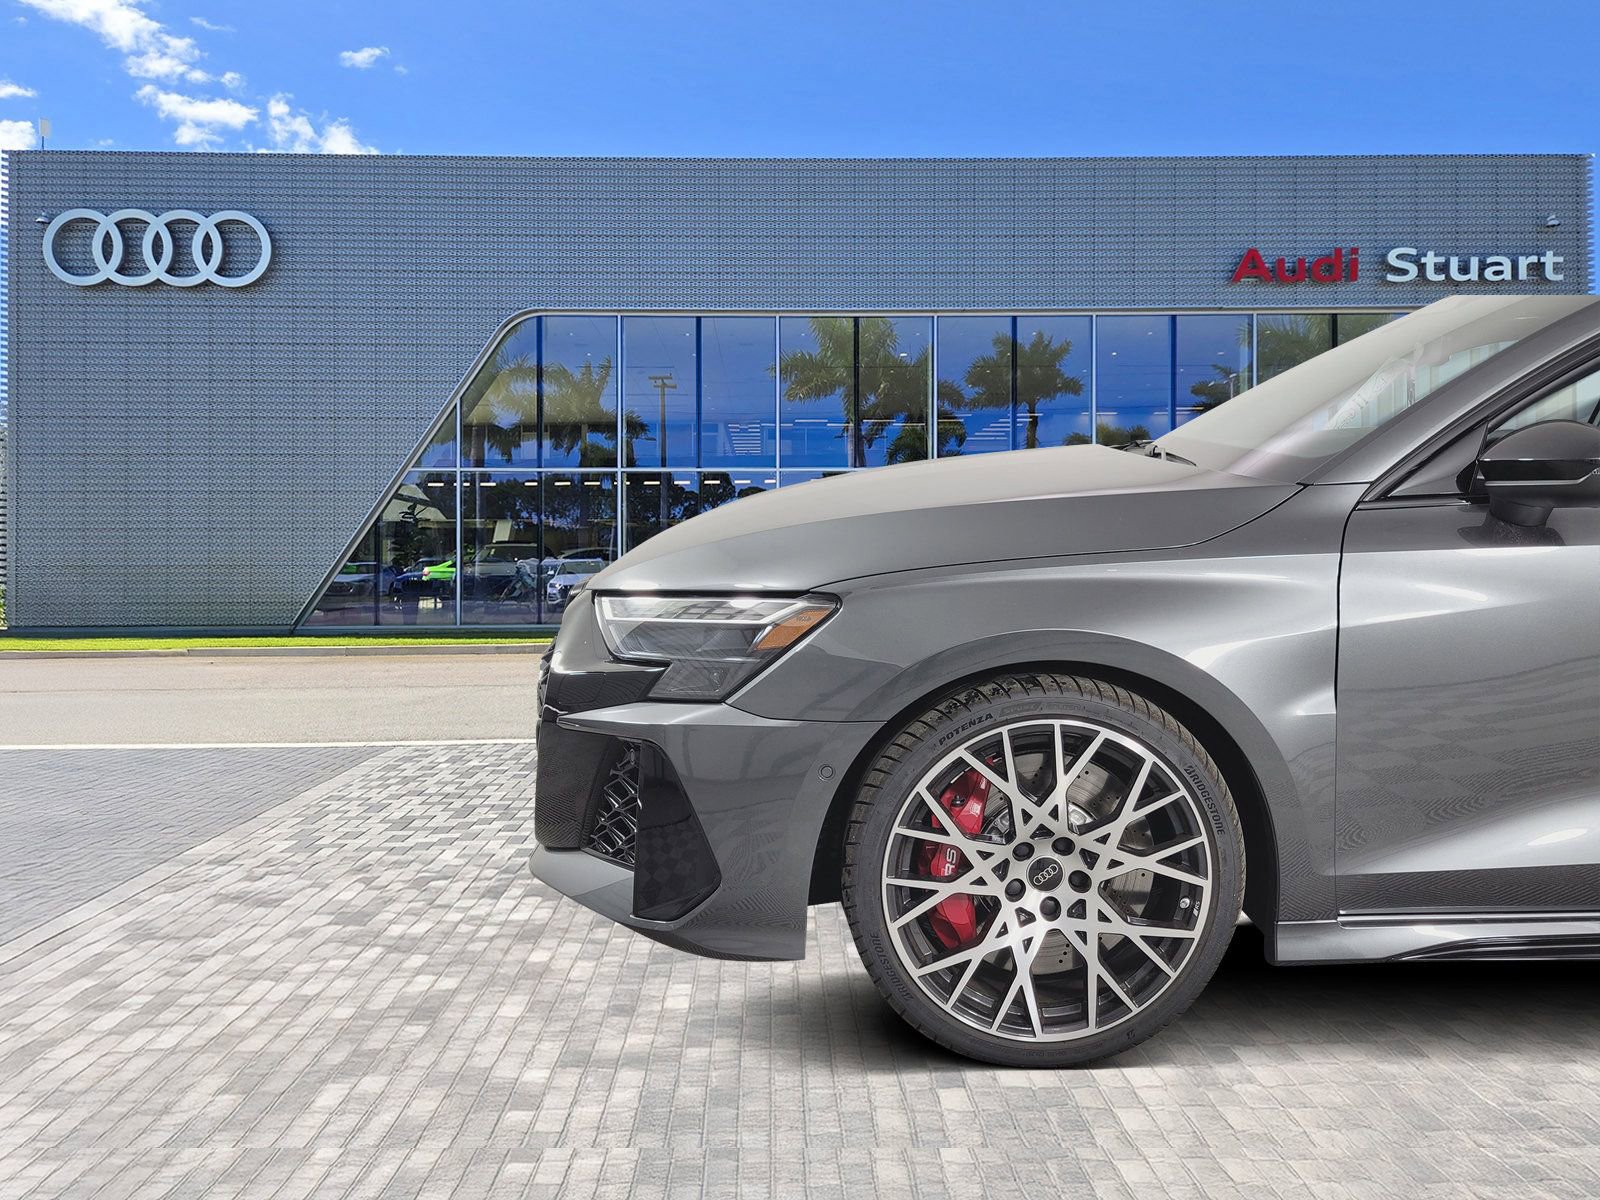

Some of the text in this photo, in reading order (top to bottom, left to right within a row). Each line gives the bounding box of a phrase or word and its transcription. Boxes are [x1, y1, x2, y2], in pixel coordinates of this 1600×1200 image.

[1231, 247, 1564, 283] Audi Stuart
[939, 713, 993, 745] POTENZA
[1184, 765, 1225, 835] BRIDGESTONE
